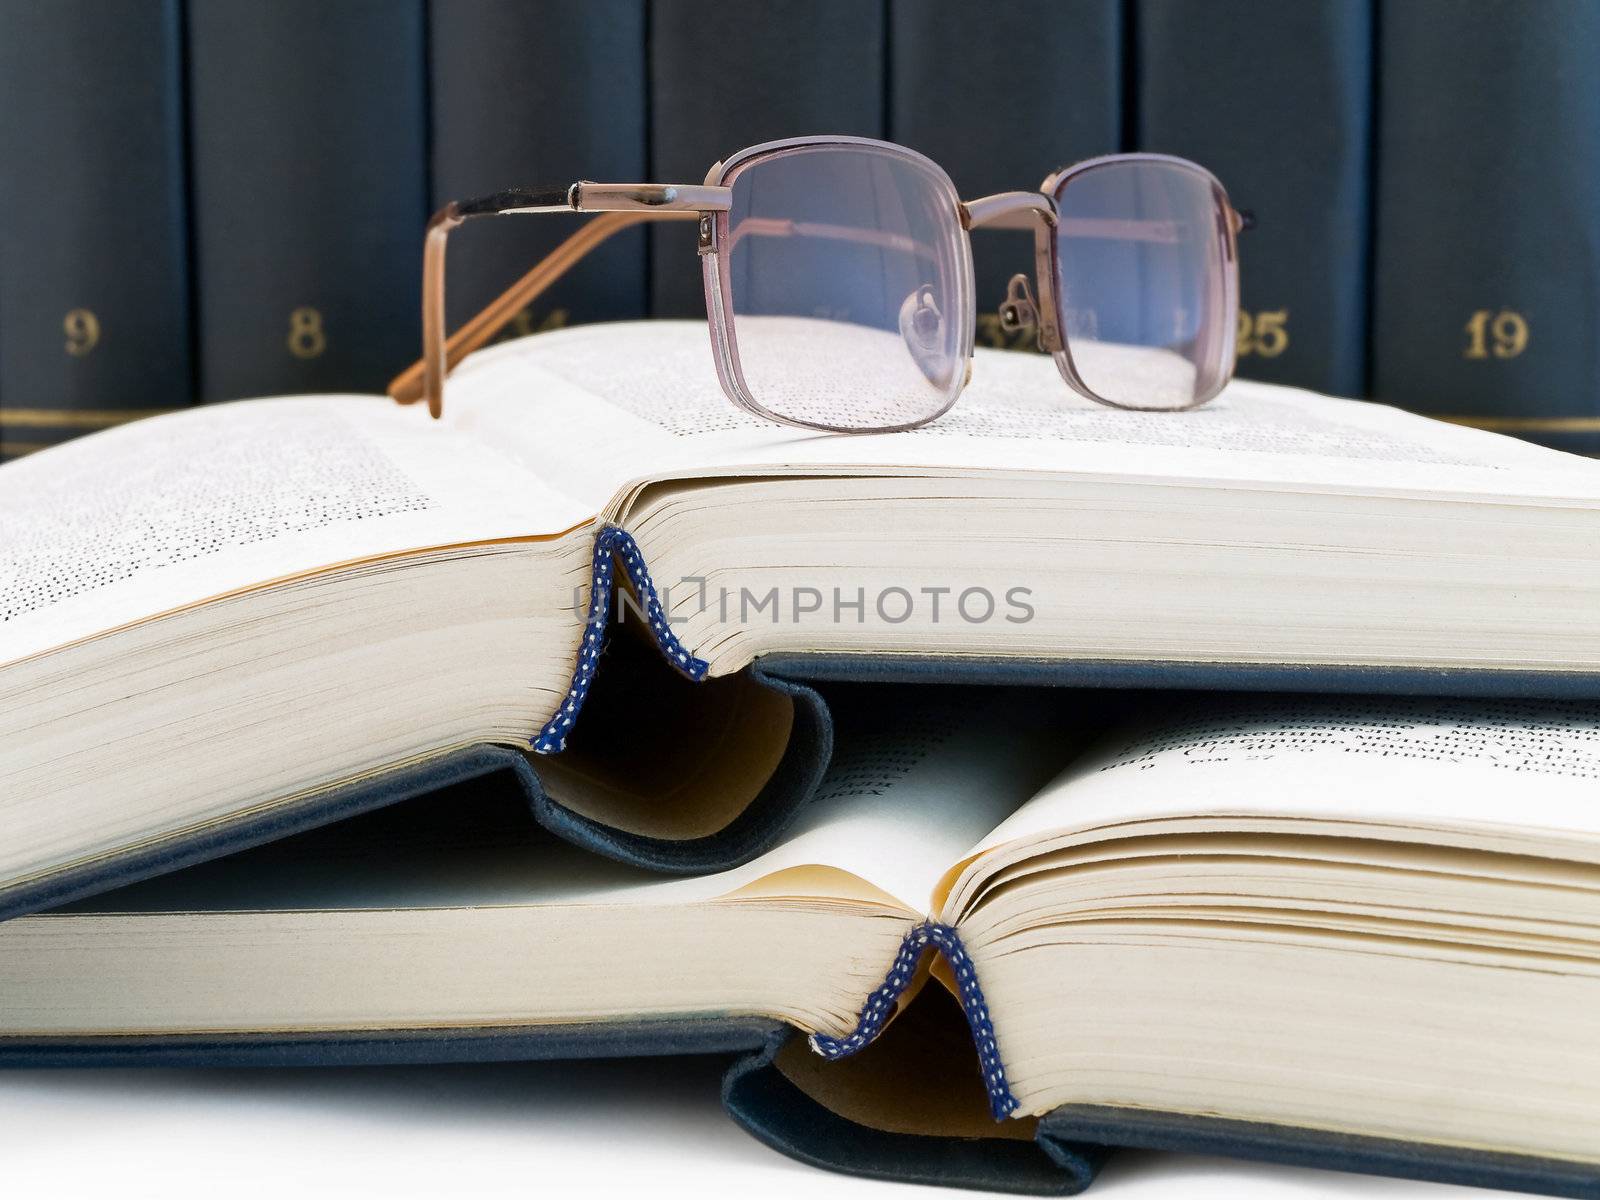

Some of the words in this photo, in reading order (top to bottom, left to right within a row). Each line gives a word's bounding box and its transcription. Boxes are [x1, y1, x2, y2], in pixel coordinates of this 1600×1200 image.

[63, 308, 100, 355] 9
[288, 307, 326, 358] 8
[1465, 309, 1530, 359] 19
